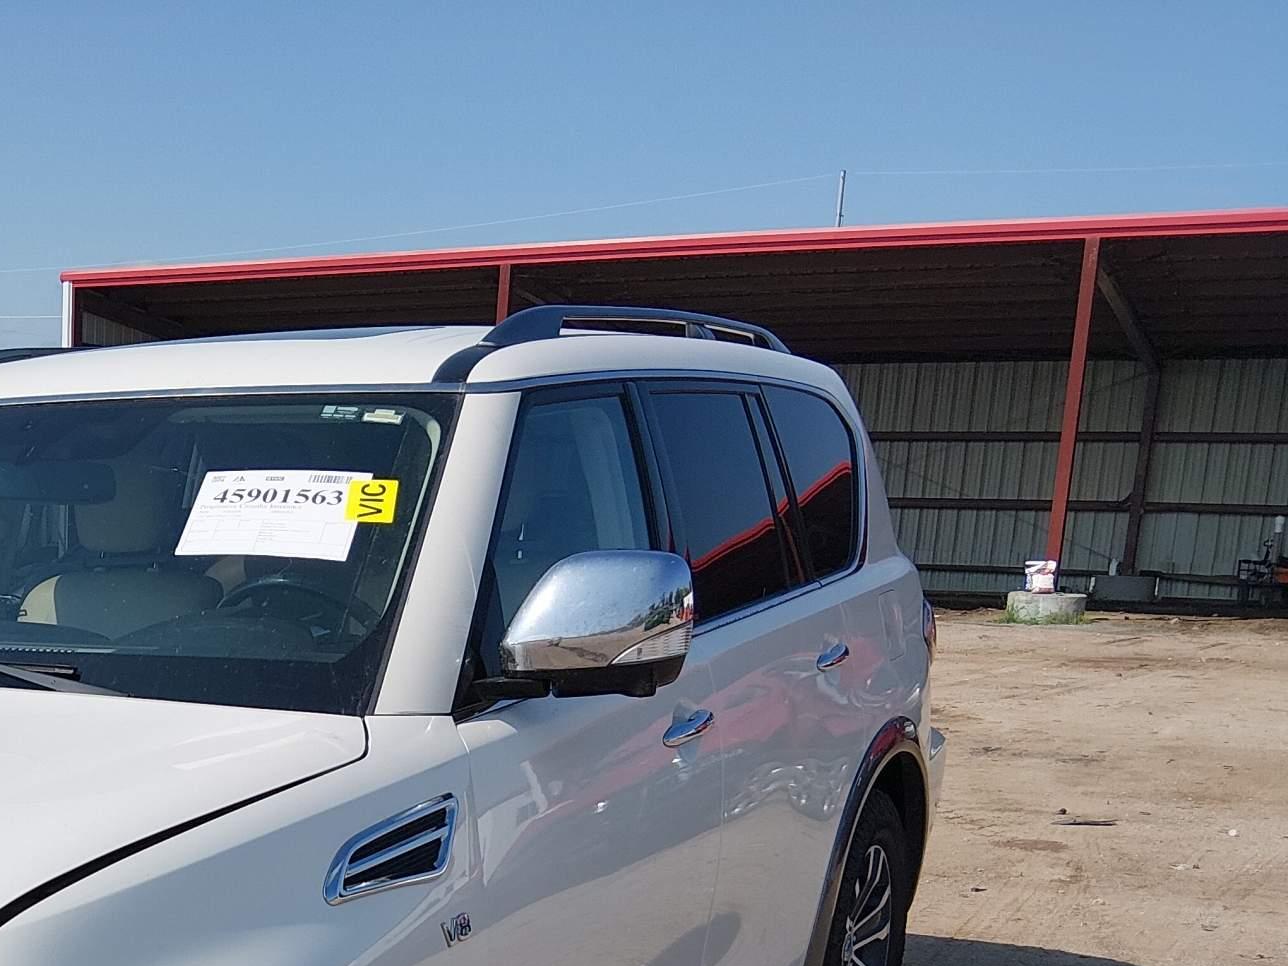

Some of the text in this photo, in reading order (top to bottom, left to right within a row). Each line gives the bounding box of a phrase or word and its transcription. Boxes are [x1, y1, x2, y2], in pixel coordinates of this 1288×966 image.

[213, 488, 343, 505] 45901563
[357, 483, 386, 518] VIC
[440, 912, 471, 948] V8
